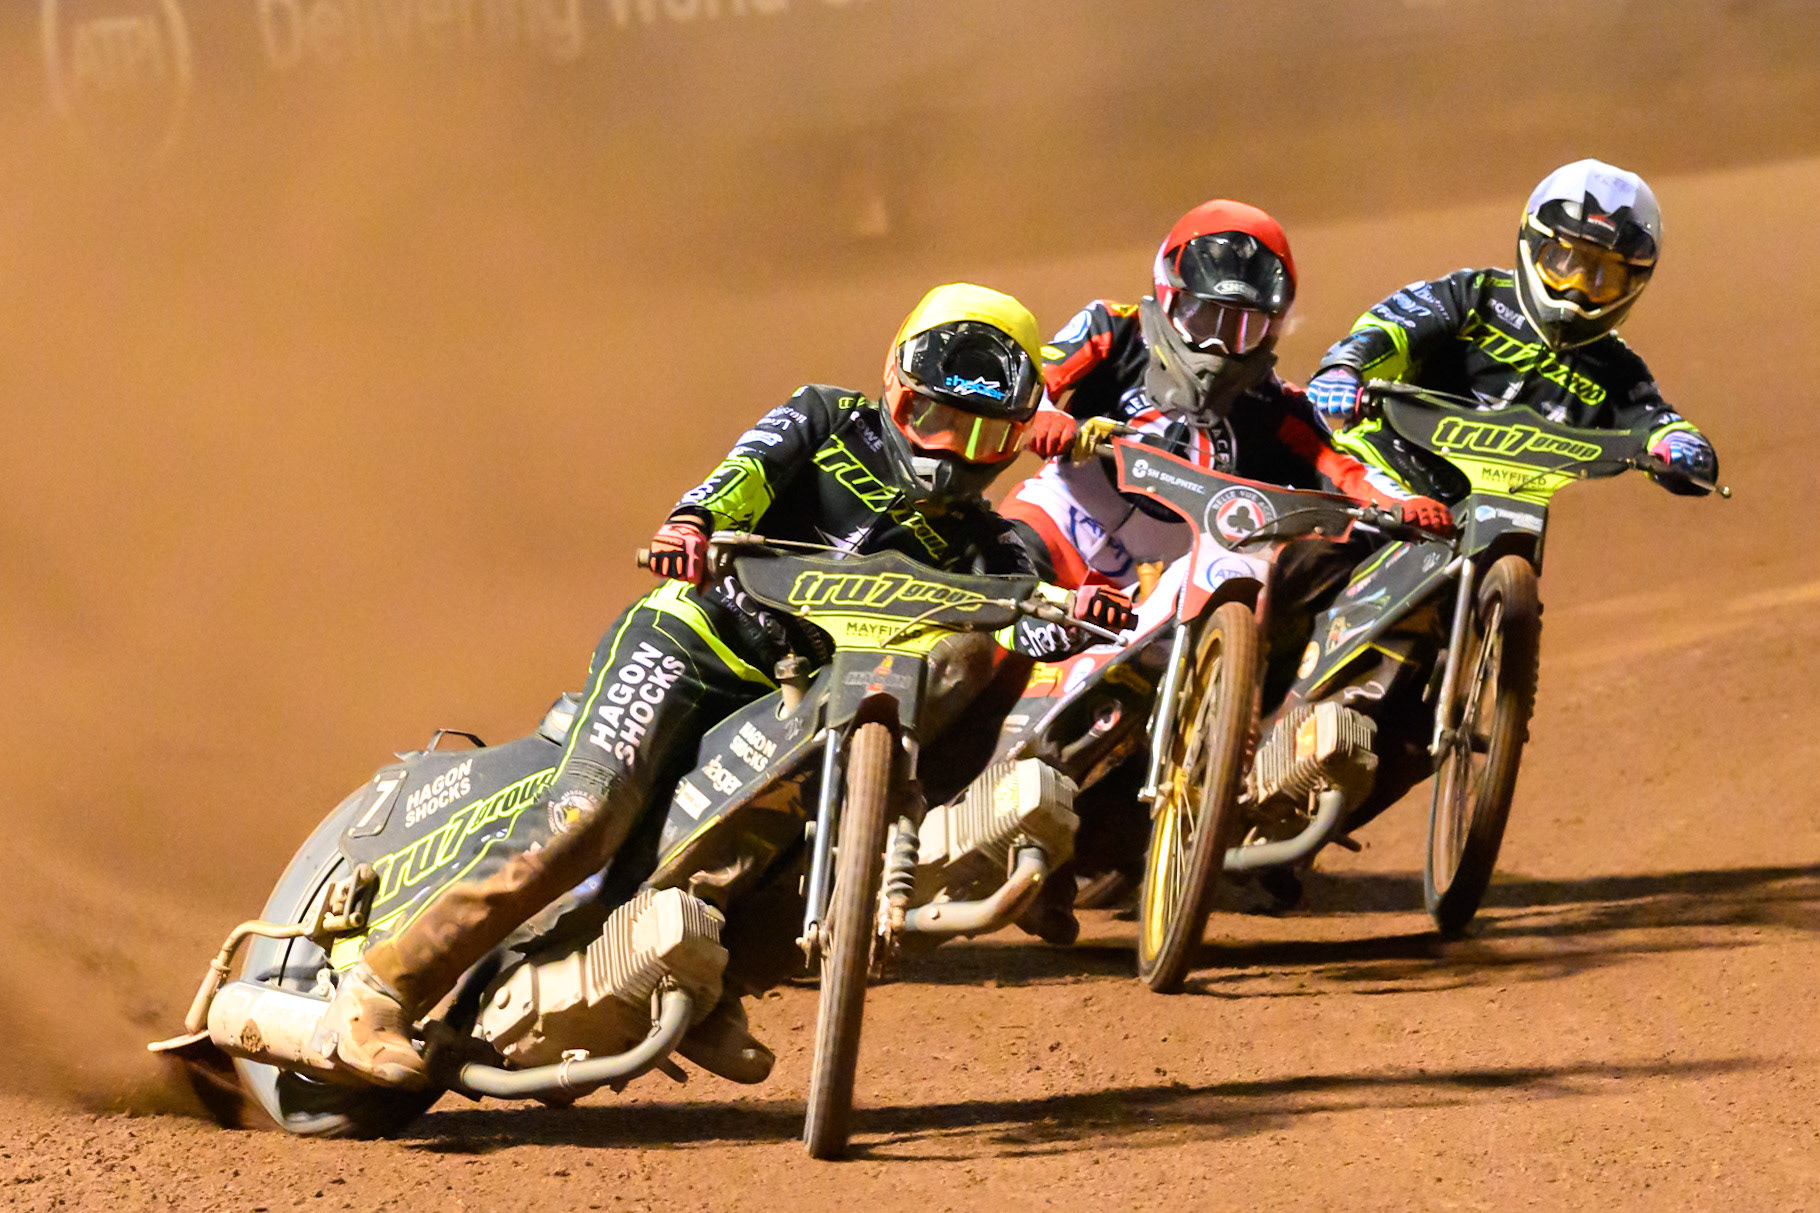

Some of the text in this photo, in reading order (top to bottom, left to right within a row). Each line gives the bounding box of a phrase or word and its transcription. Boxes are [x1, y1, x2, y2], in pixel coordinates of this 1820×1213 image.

[589, 641, 664, 753] HAGON
[614, 655, 686, 766] SHOCKS
[356, 779, 399, 828] 7
[405, 777, 471, 828] SHOCKS
[406, 758, 473, 812] HAGON
